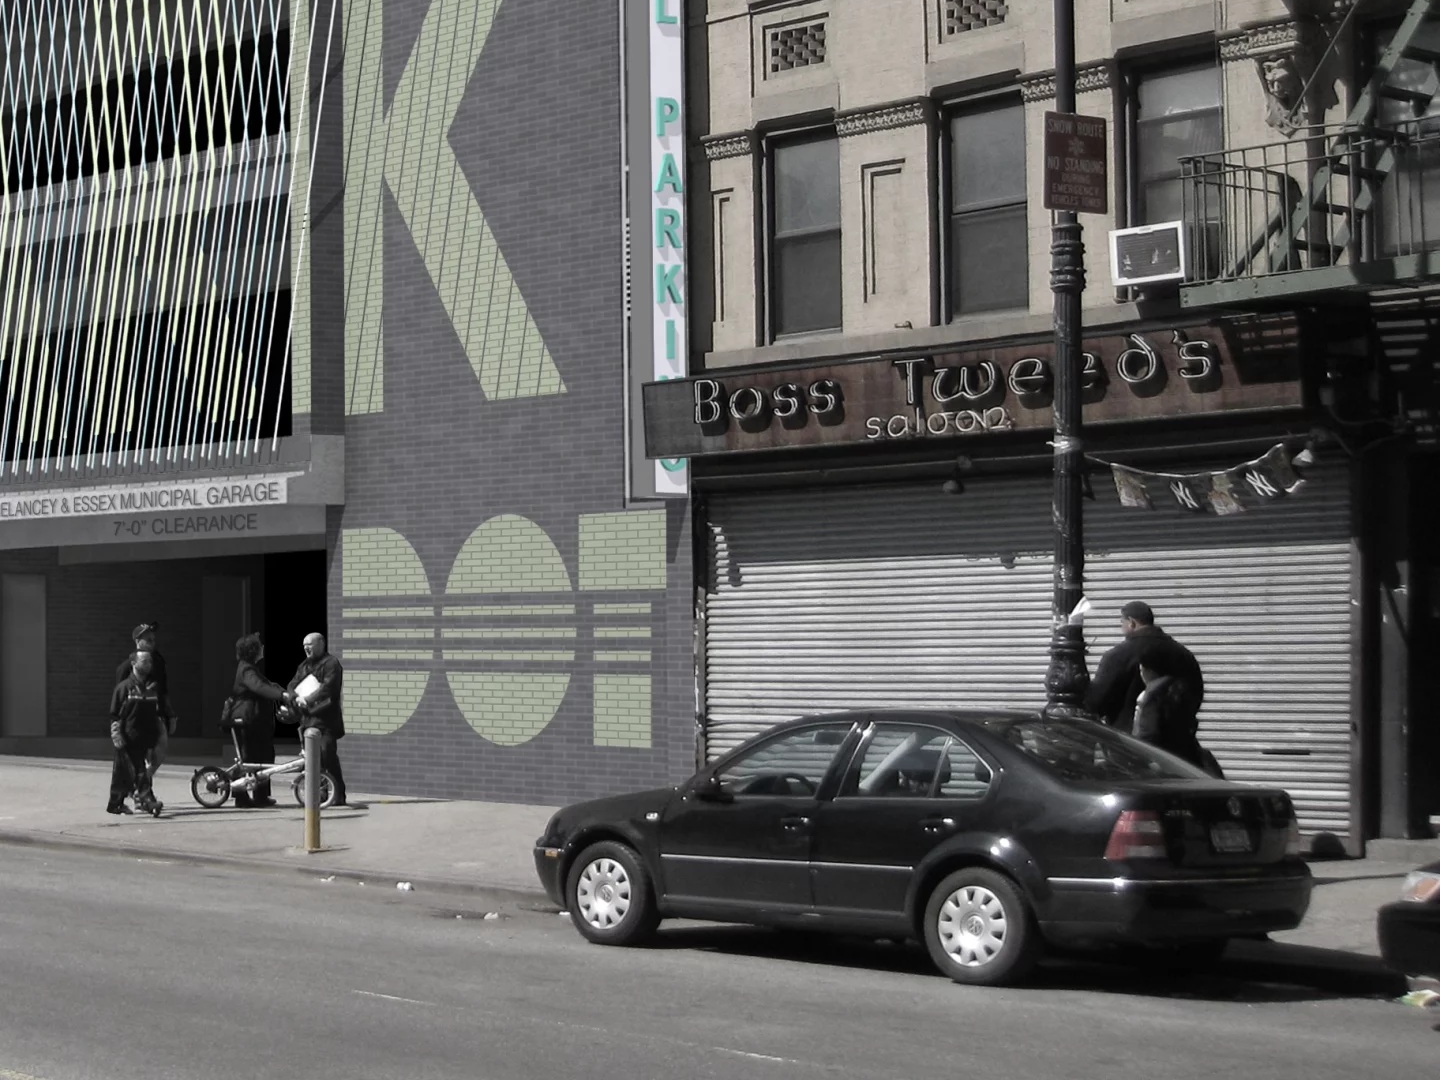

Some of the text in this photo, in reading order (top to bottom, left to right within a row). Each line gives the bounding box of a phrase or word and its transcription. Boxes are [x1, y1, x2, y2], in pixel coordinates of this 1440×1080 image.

[1047, 118, 1104, 138] SNOW ROUTE
[1047, 155, 1104, 175] NO STANDING
[1051, 183, 1100, 196] EMERGENCY
[654, 97, 687, 472] PARKI
[866, 406, 1007, 439] saloon
[60, 500, 70, 513] &
[73, 493, 116, 513] ESSEX
[120, 487, 202, 510] MUNICIPAL
[206, 482, 279, 505] GARAGE
[151, 513, 258, 535] CLEARANCE
